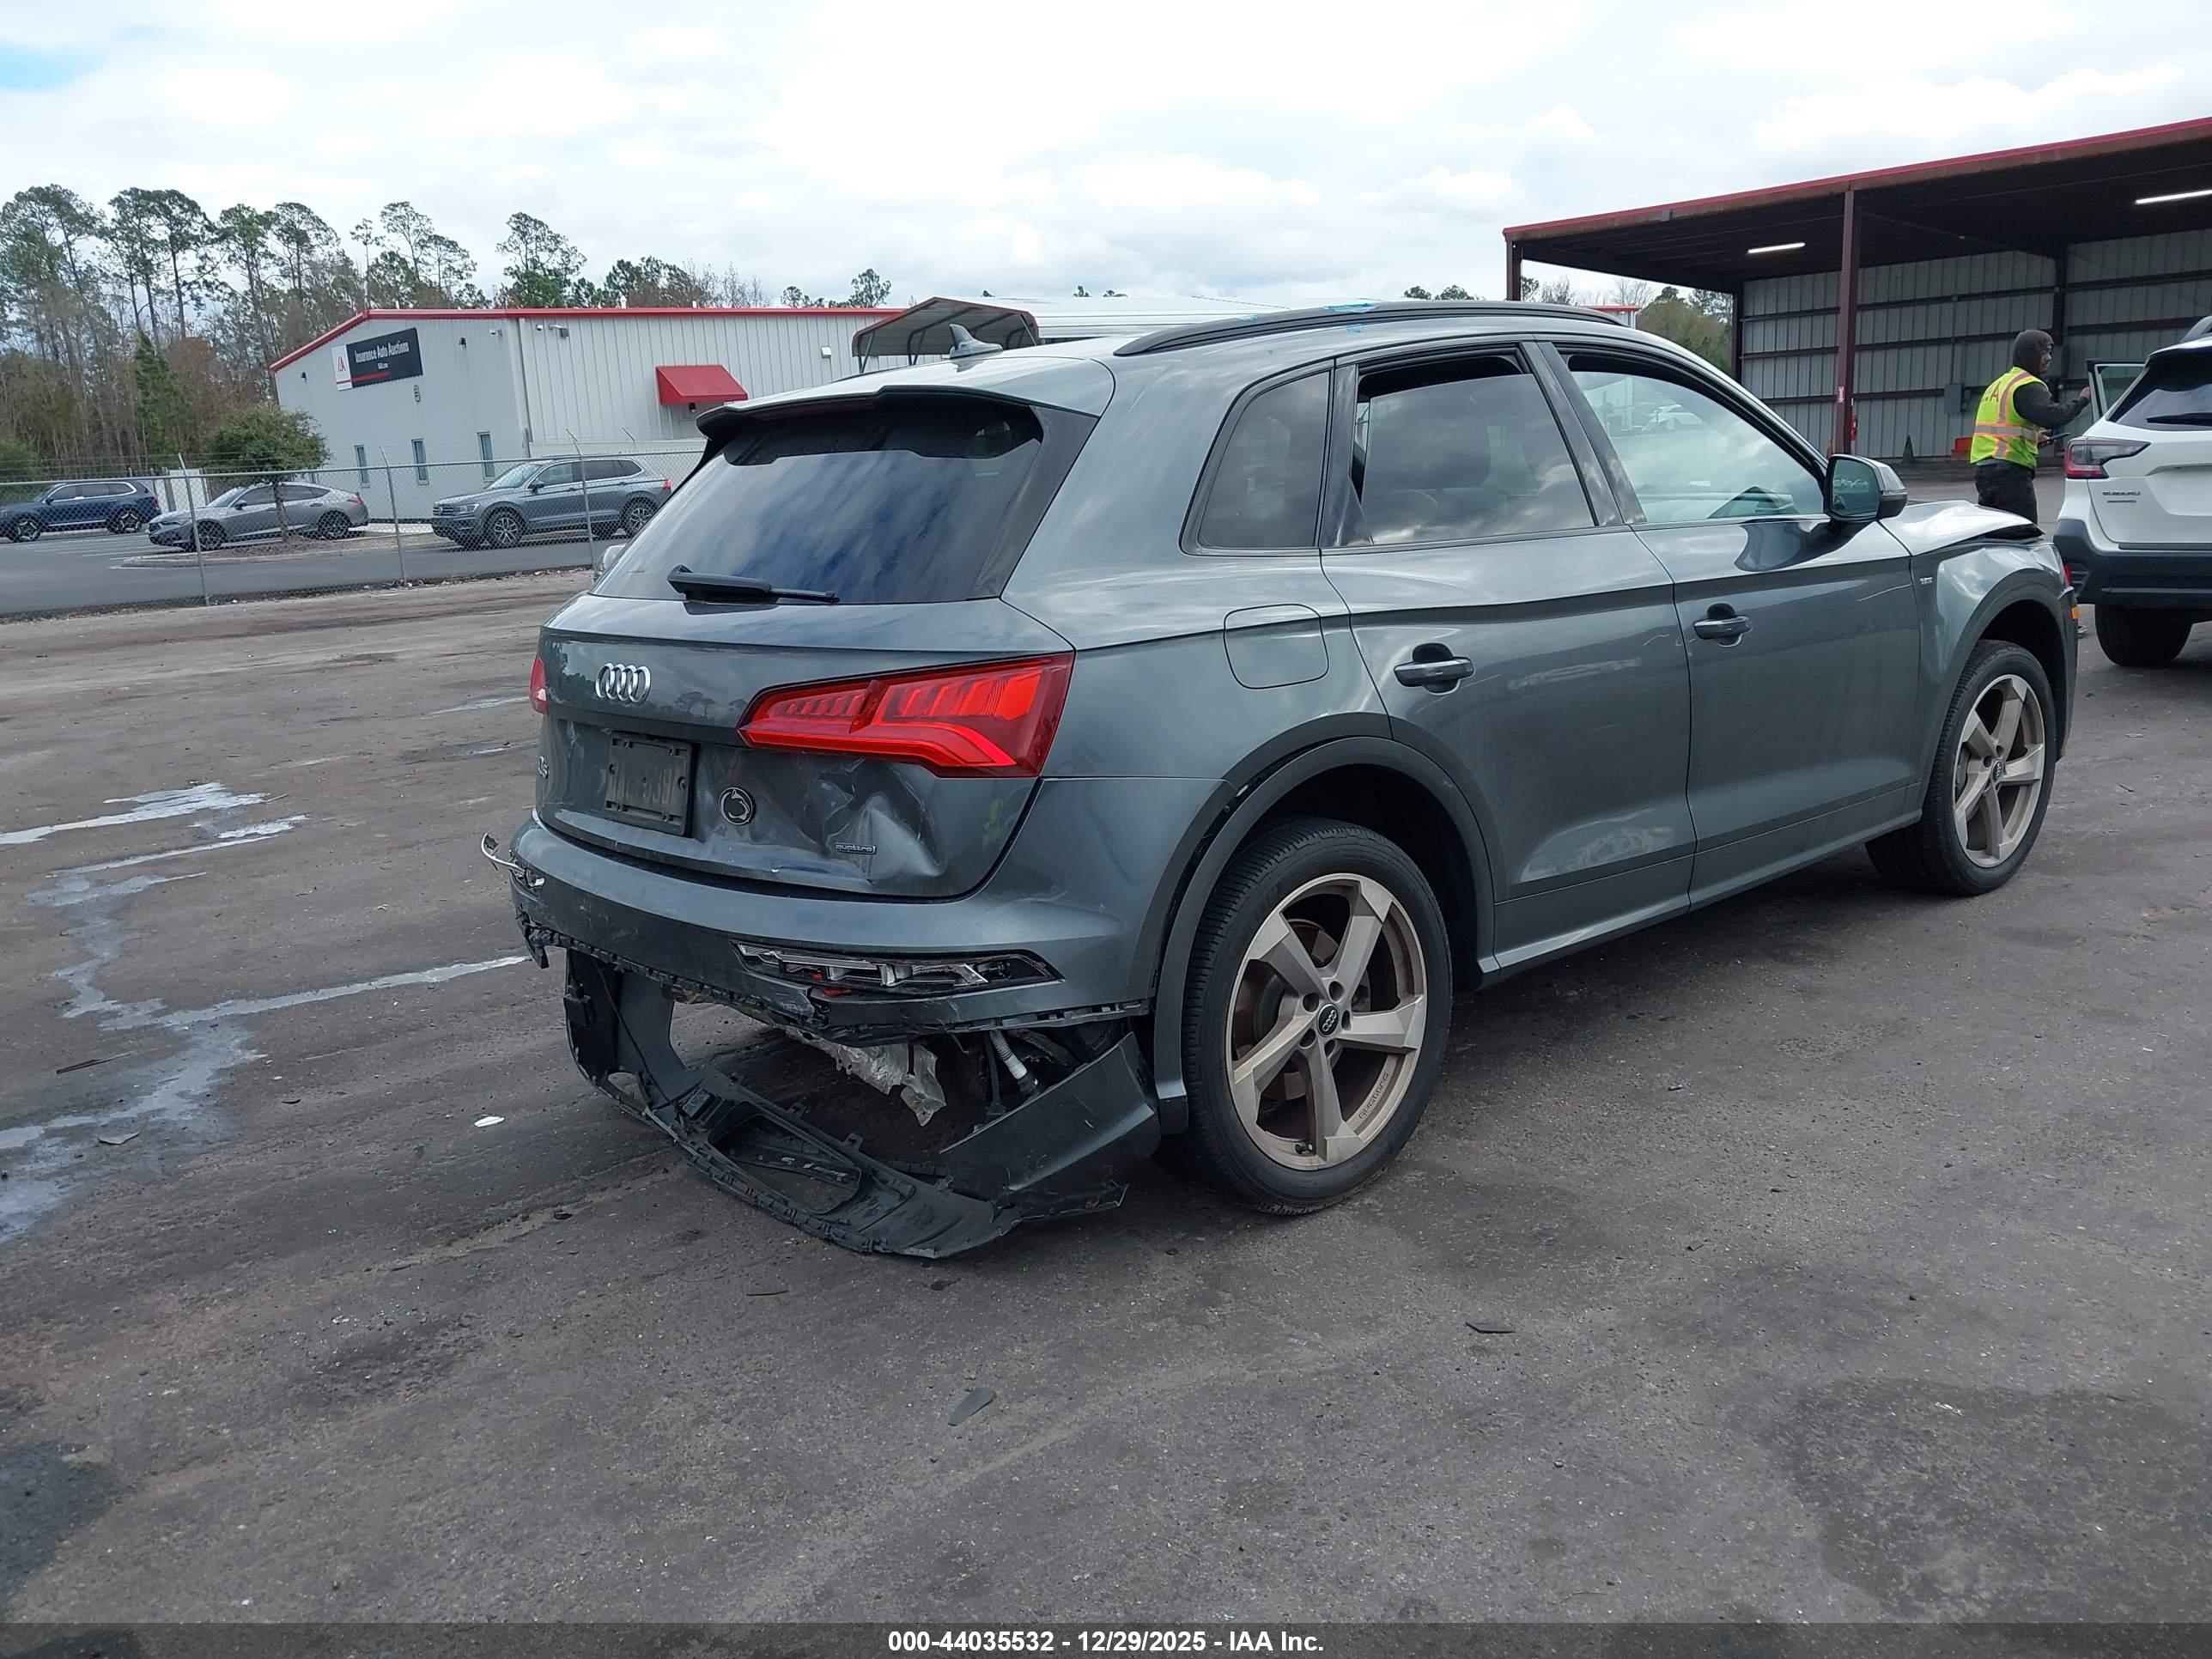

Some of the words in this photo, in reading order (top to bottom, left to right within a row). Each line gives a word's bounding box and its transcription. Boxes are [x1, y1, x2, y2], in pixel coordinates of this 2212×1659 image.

[355, 349, 377, 363] Insurance
[376, 345, 388, 359] Auto
[388, 340, 410, 356] Auctions
